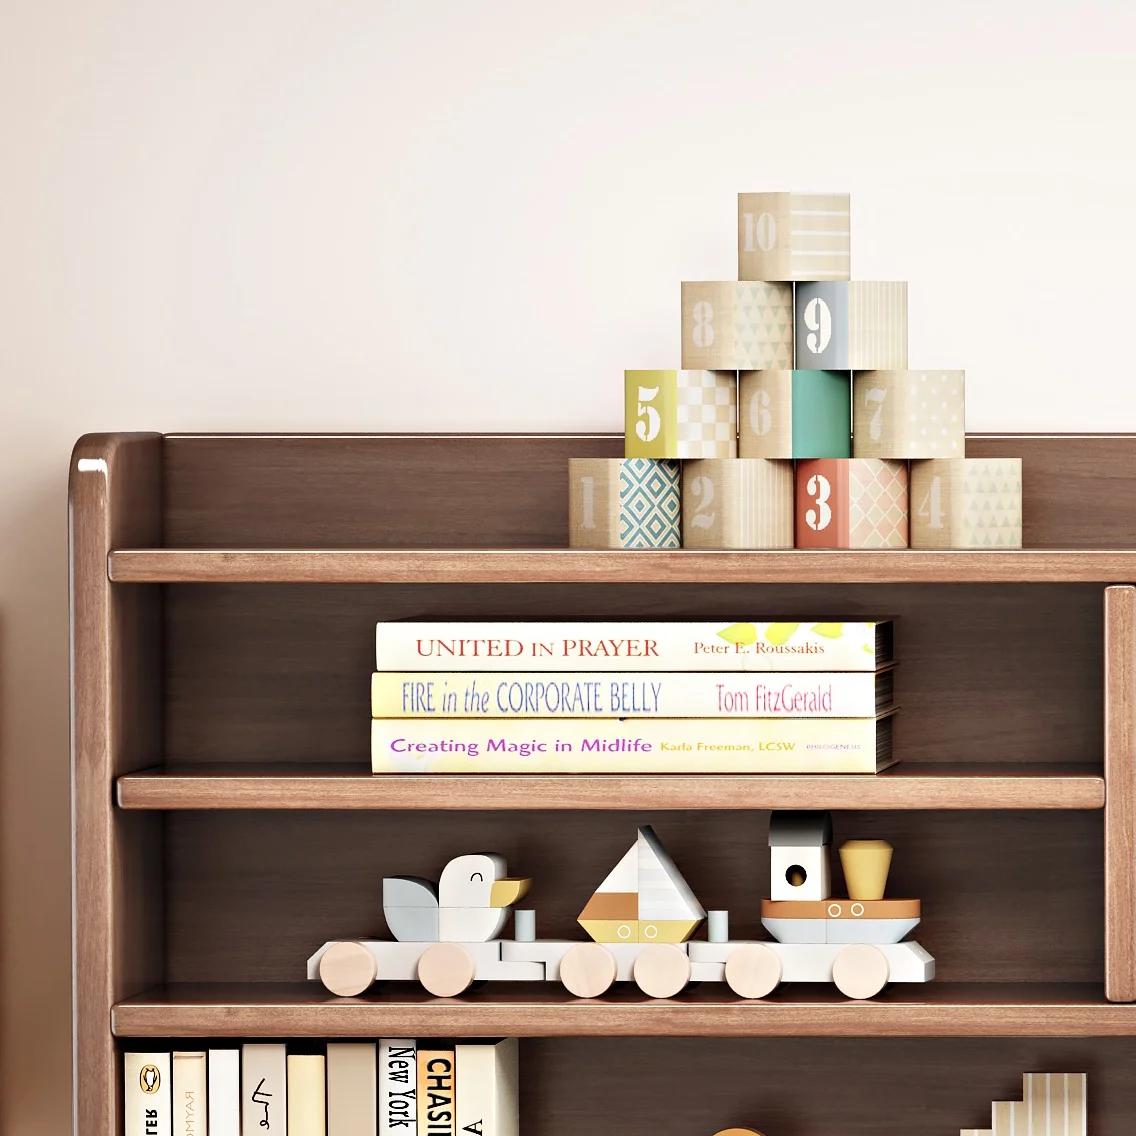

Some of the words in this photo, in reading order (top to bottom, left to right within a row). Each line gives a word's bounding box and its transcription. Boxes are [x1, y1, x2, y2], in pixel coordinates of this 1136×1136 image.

[743, 212, 777, 252] 10
[691, 301, 715, 348] 8
[803, 297, 832, 354] 9
[635, 385, 661, 442] 5
[749, 389, 772, 436] 6
[863, 388, 887, 440] 7
[580, 476, 597, 529] 1
[690, 476, 715, 529] 2
[805, 474, 832, 531] 3
[918, 476, 944, 529] 4
[416, 639, 524, 657] UNITED
[531, 642, 553, 657] IN
[562, 639, 660, 657] PRAYER
[694, 639, 730, 654] Peter
[734, 639, 752, 657] E.
[754, 639, 828, 657] Roussakis
[402, 681, 436, 713] FIRE
[442, 681, 458, 713] in
[464, 680, 490, 714] the
[496, 681, 603, 714] CORPORATE
[610, 682, 662, 713] BELLY
[715, 684, 749, 713] Tom
[755, 684, 832, 713] FitzGerald
[390, 738, 479, 757] Creating
[486, 738, 547, 757] Magic
[555, 739, 573, 752] in
[580, 738, 653, 753] Midlife
[660, 742, 693, 751] Karla
[697, 742, 754, 752] Freeman,
[758, 741, 796, 751] LCSW
[387, 1045, 417, 1086] New
[387, 1088, 417, 1130] York
